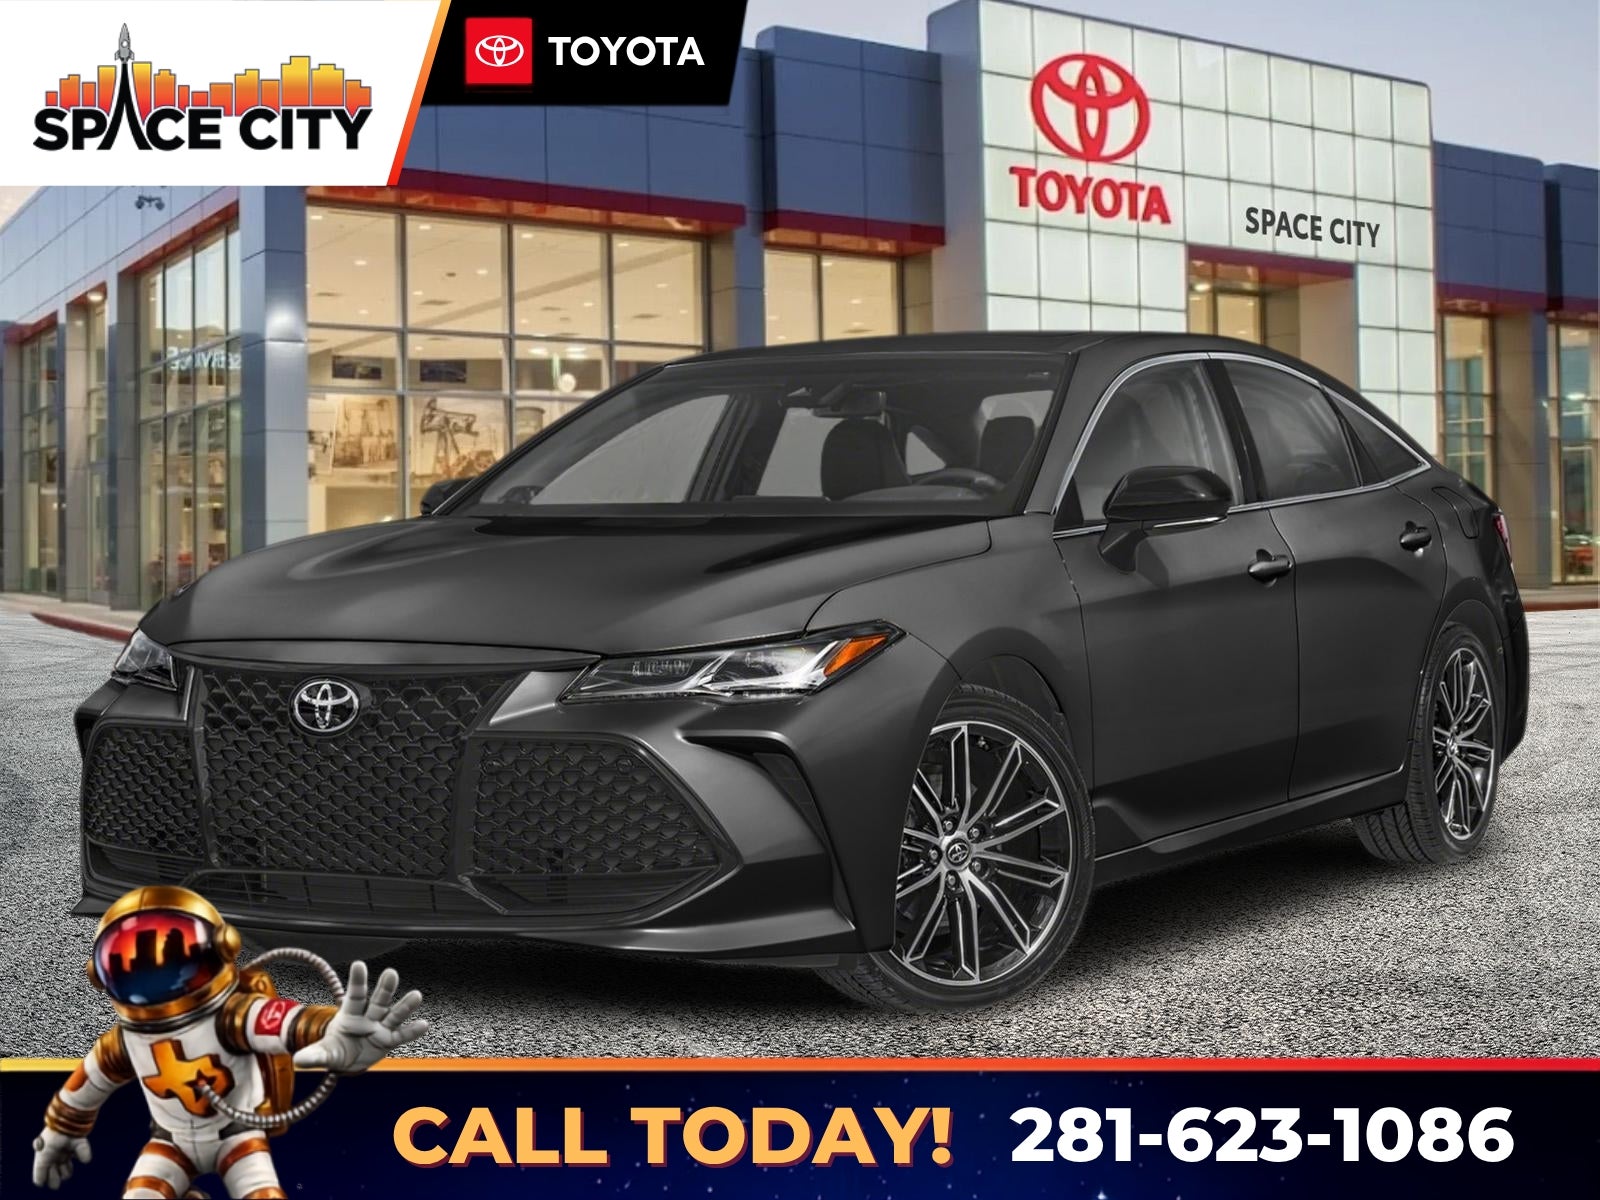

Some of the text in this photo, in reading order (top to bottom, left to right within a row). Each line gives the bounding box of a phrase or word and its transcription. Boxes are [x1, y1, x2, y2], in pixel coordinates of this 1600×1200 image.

[1008, 165, 1172, 226] TOYOTA
[1245, 206, 1381, 249] SPACE CITY
